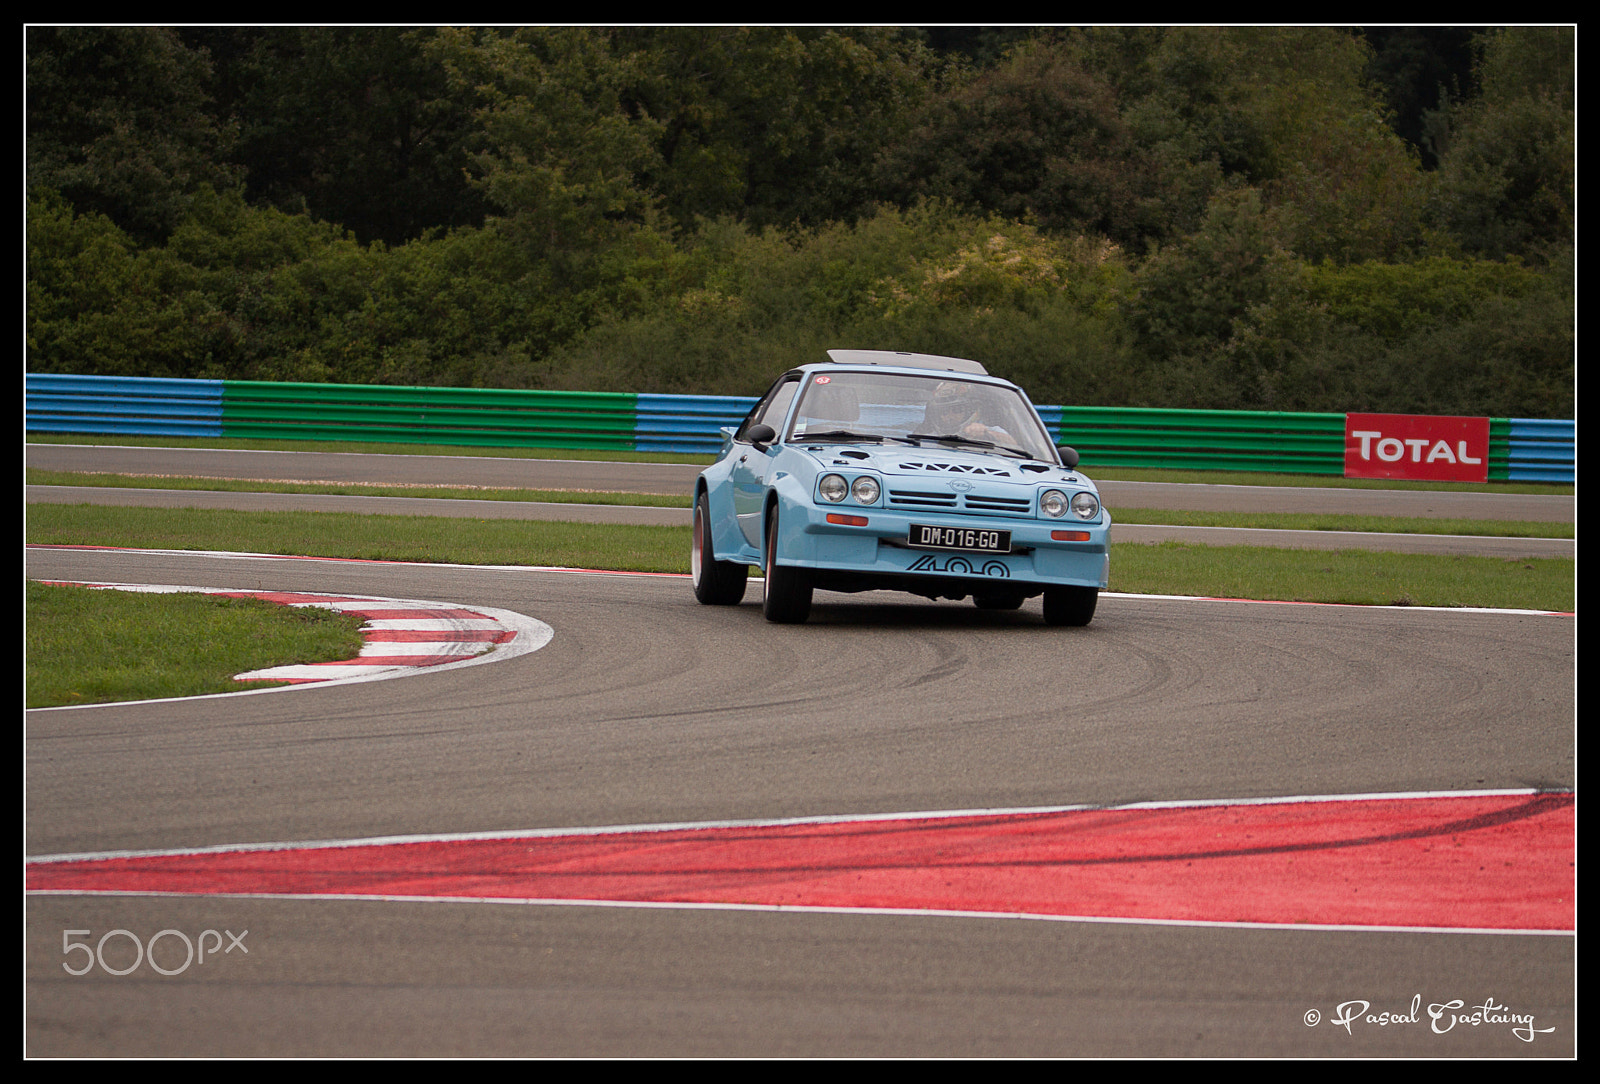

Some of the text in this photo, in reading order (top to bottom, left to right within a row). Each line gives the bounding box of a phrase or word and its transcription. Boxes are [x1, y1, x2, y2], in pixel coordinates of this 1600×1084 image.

[1352, 430, 1482, 465] TOTAL
[921, 527, 999, 549] DM-016-GQ
[906, 555, 1011, 578] 400
